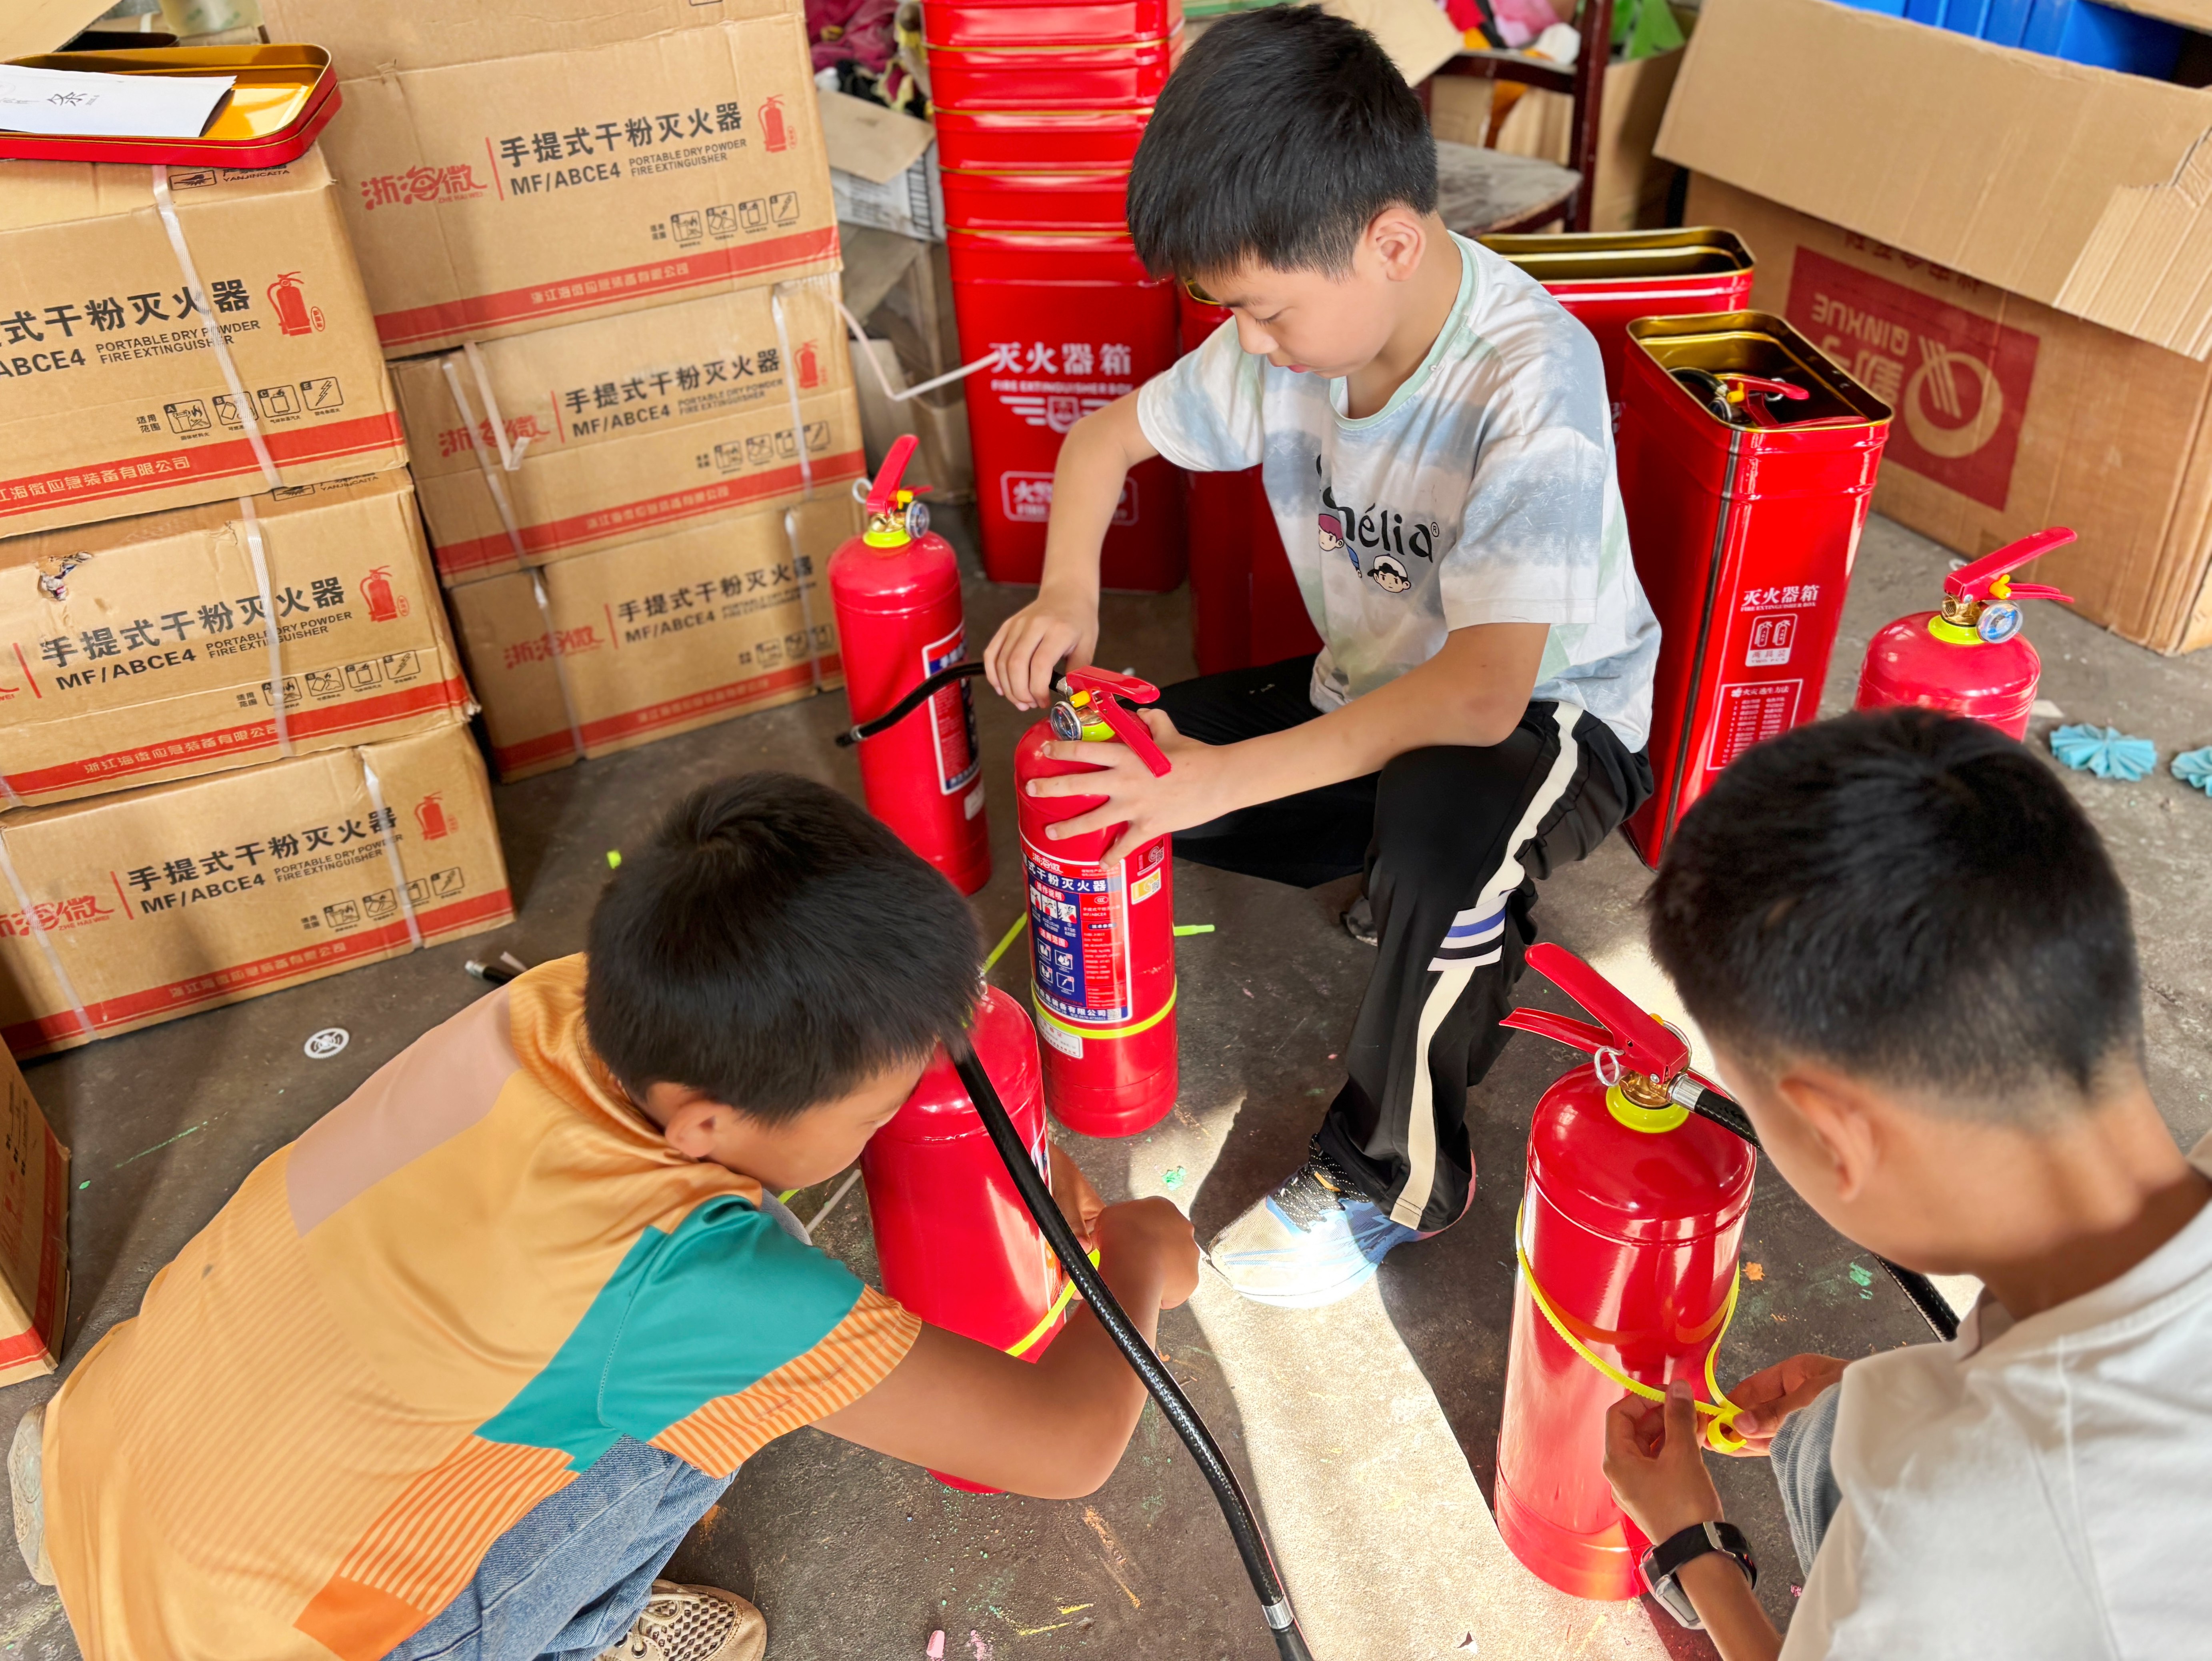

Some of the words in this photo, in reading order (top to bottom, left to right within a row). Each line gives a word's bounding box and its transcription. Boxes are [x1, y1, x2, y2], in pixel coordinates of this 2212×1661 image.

[500, 102, 741, 167] 手提式干粉灭火器
[629, 150, 681, 166] PORTABLE
[683, 147, 703, 158] DRY
[705, 139, 747, 154] POWDER
[631, 166, 654, 177] FIRE
[656, 152, 728, 172] EXTINGUISHER
[510, 162, 621, 196] MF/ABCE4
[96, 334, 168, 353] PORTABLE
[172, 329, 198, 341] DRY
[202, 320, 261, 337] PWDER
[1811, 292, 1910, 358] QINXUE
[100, 349, 132, 364] FIRE
[134, 334, 235, 359] EXTINGUISHR
[988, 341, 1132, 376] 灭火器箱
[565, 348, 780, 414] 手提式干粉灭火器
[572, 404, 671, 437] MF/ABCE4
[1741, 584, 1820, 607] 灭火器箱
[41, 577, 344, 668] 手提式干粉灭火器
[300, 611, 352, 628] POWDER
[625, 611, 715, 643] MF/ABCE4
[208, 646, 238, 658] FIRE
[239, 625, 329, 652] EXTIGUISHER
[56, 648, 197, 690] MF/ABCE4
[128, 807, 397, 892] 手提式干粉灭火器
[274, 855, 332, 875] PORTABLE
[334, 849, 355, 860] DRY
[277, 870, 302, 883] FIRE
[304, 849, 383, 877] EXTINGUISHER
[140, 873, 266, 914] MF/ABCE4
